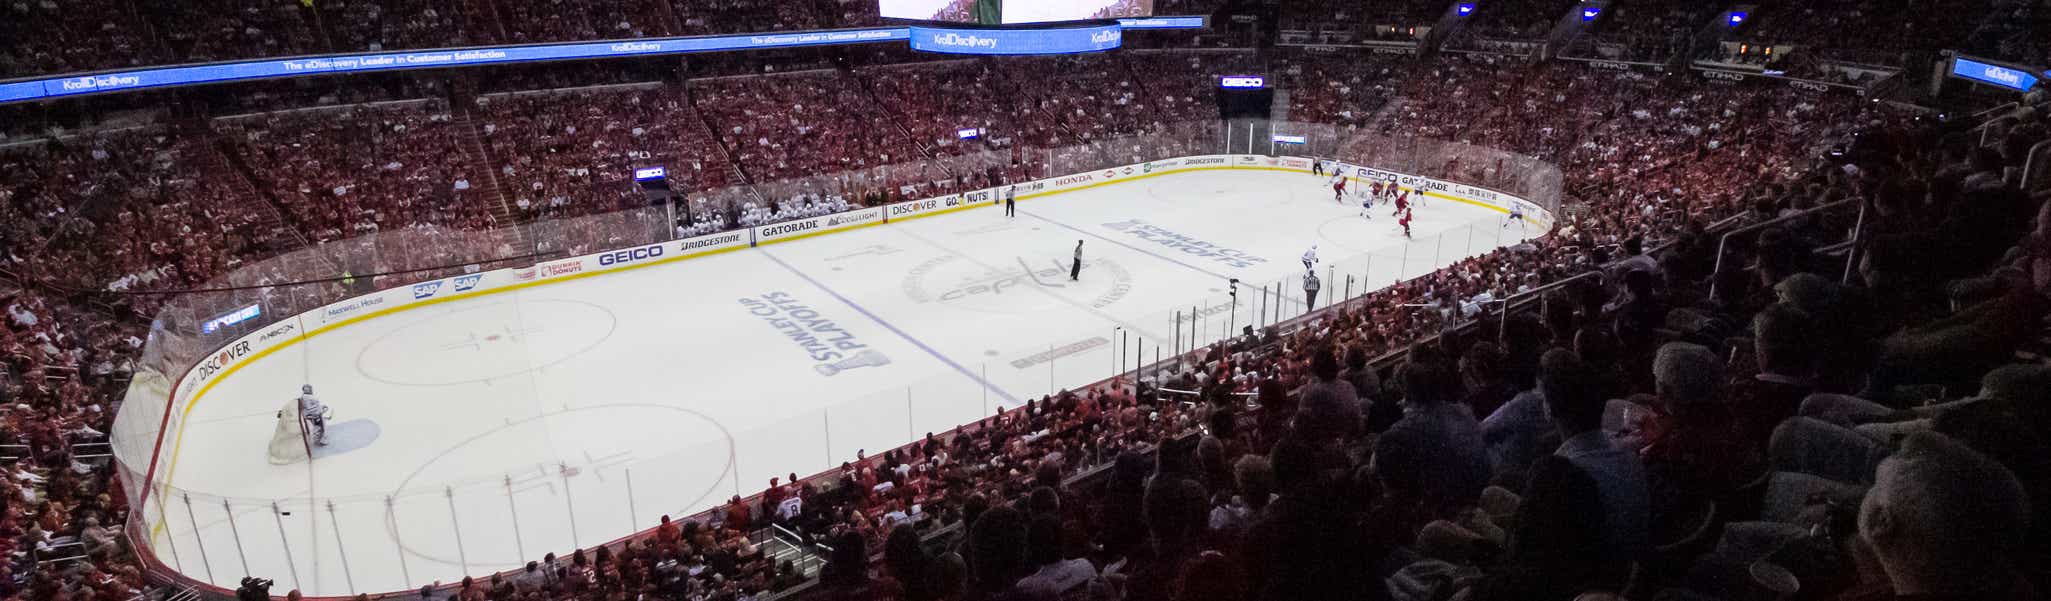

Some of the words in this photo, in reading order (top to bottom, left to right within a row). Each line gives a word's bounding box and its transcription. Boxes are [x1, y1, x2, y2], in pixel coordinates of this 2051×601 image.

[283, 62, 302, 71] The
[305, 60, 358, 70] eDiscovery
[360, 57, 394, 66] Leader
[406, 54, 452, 63] Customer
[454, 51, 506, 61] Satisfaction
[1055, 174, 1093, 187] HONDA
[1402, 177, 1448, 192] GATRADE
[893, 199, 936, 216] DISCOVER
[762, 220, 819, 237] GATORADE
[681, 234, 741, 251] BRIDGESTONE
[599, 245, 664, 267] GEICO
[415, 284, 439, 297] SAP
[455, 277, 479, 290] SAP
[738, 297, 779, 317] CUP
[761, 291, 868, 350] PLAYOFFS
[765, 316, 843, 362] STANLEY
[199, 340, 251, 381] DISCOVER
